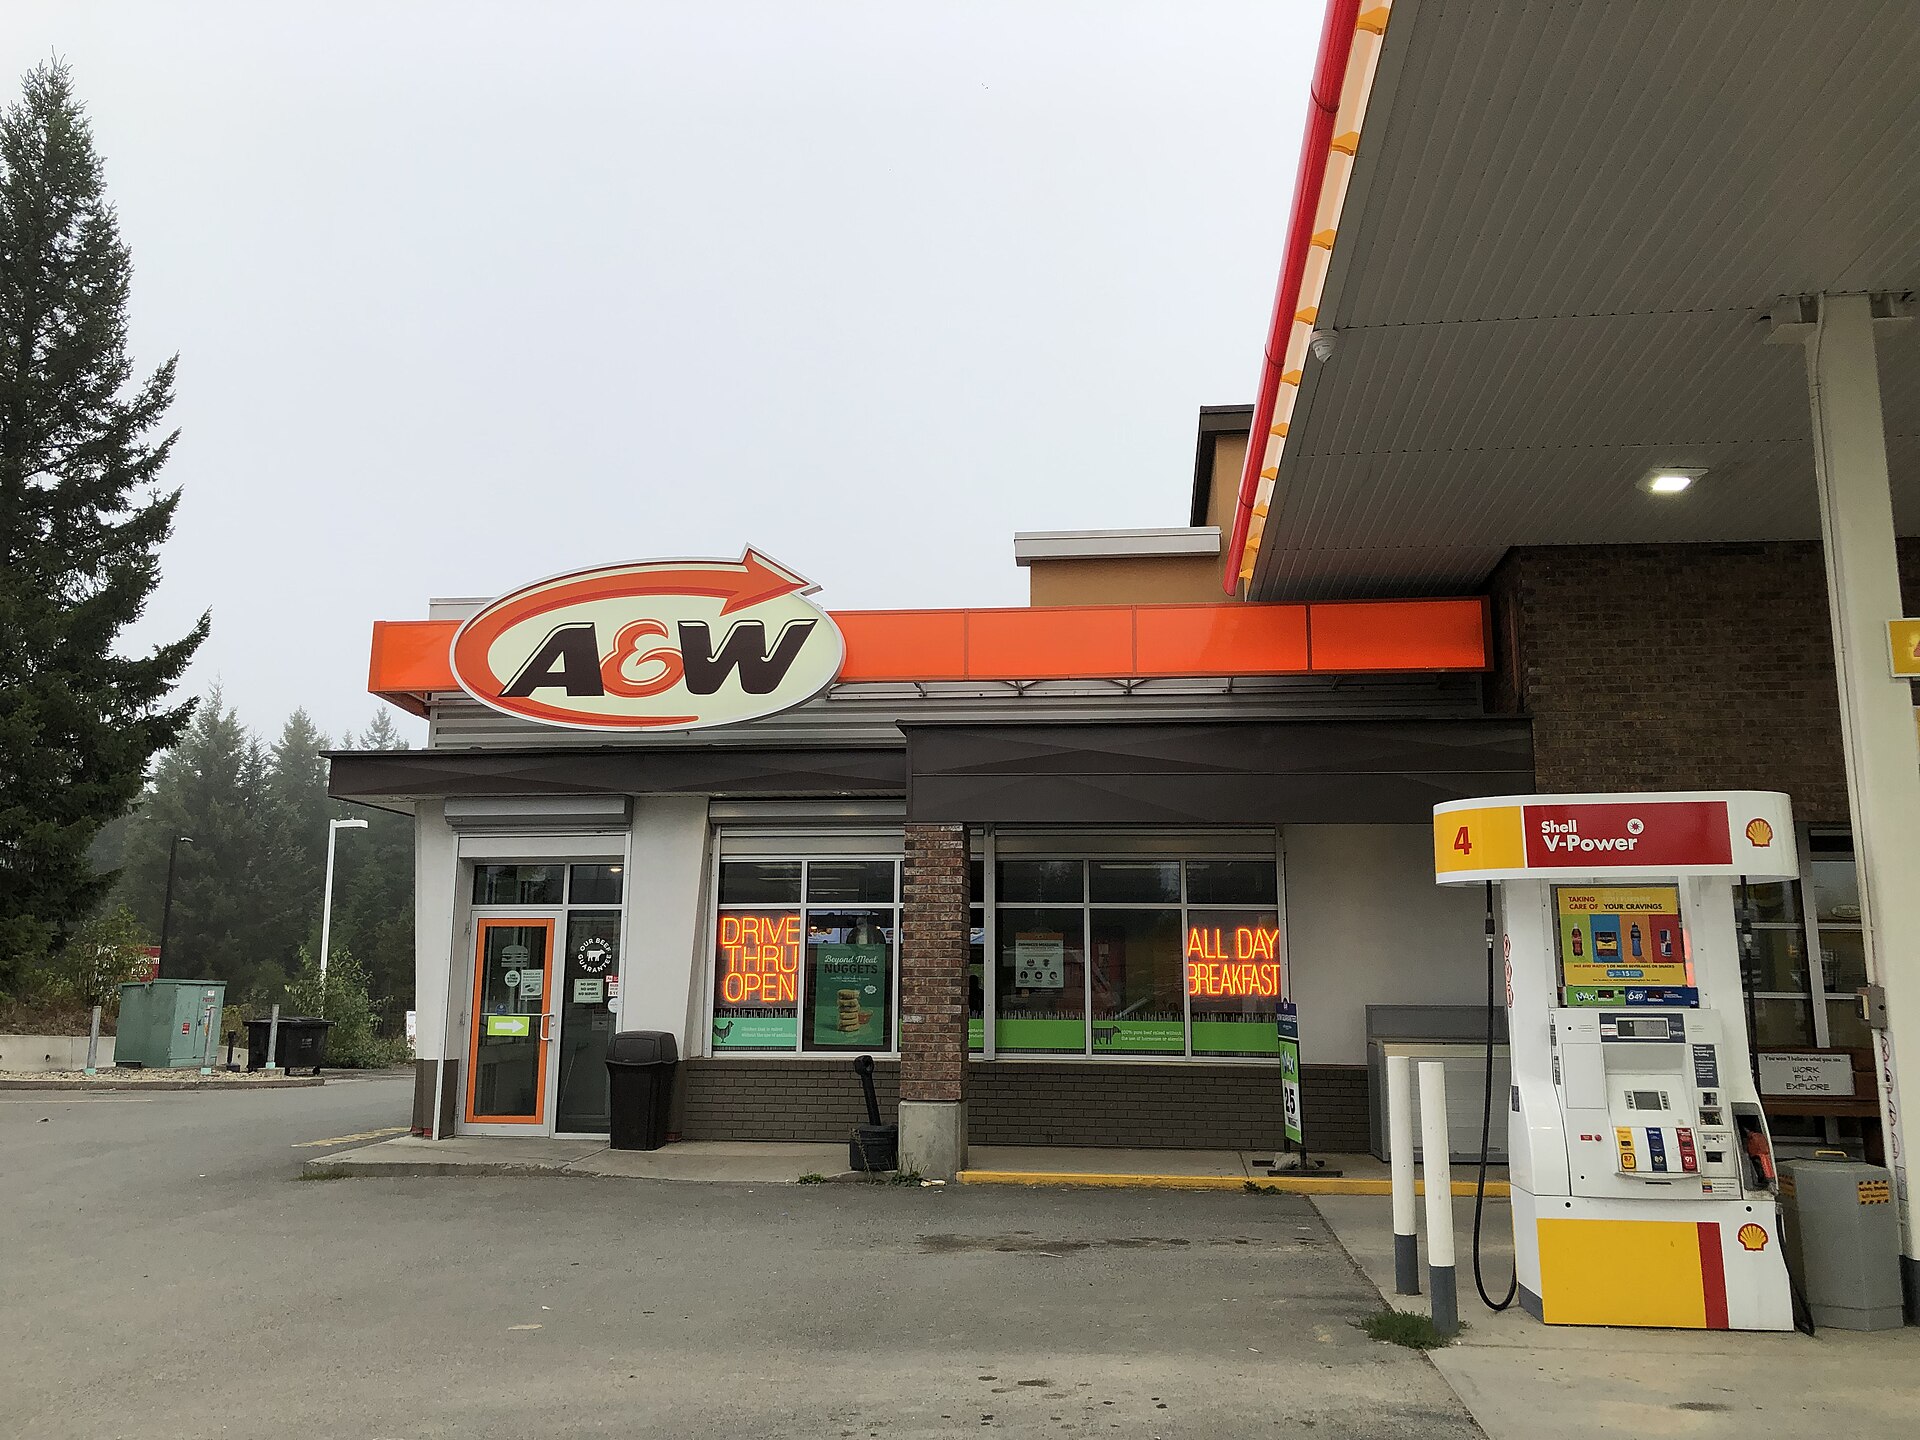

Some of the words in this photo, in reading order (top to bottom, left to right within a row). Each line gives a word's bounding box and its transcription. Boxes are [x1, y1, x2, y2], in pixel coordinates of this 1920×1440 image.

[497, 618, 819, 699] A&W
[1541, 820, 1578, 834] Shell
[1453, 826, 1473, 855] 4
[1543, 834, 1638, 852] V-Power
[721, 916, 800, 945] DRIVE
[579, 938, 594, 952] OUR
[595, 937, 612, 952] BEEF
[1188, 928, 1229, 959] ALL
[1237, 928, 1280, 959] DAY
[577, 953, 612, 973] GUARANTEE
[724, 945, 798, 973] THRU
[824, 954, 854, 966] Beyond
[855, 955, 878, 964] Meat
[824, 963, 878, 974] NUGGETS
[724, 972, 796, 1002] OPEN
[1188, 963, 1280, 996] BREAKFAST
[1792, 1066, 1820, 1074] WORK
[1794, 1074, 1820, 1082] PLAY
[1785, 1082, 1831, 1091] EXPLORE
[1654, 1155, 1664, 1163] 89
